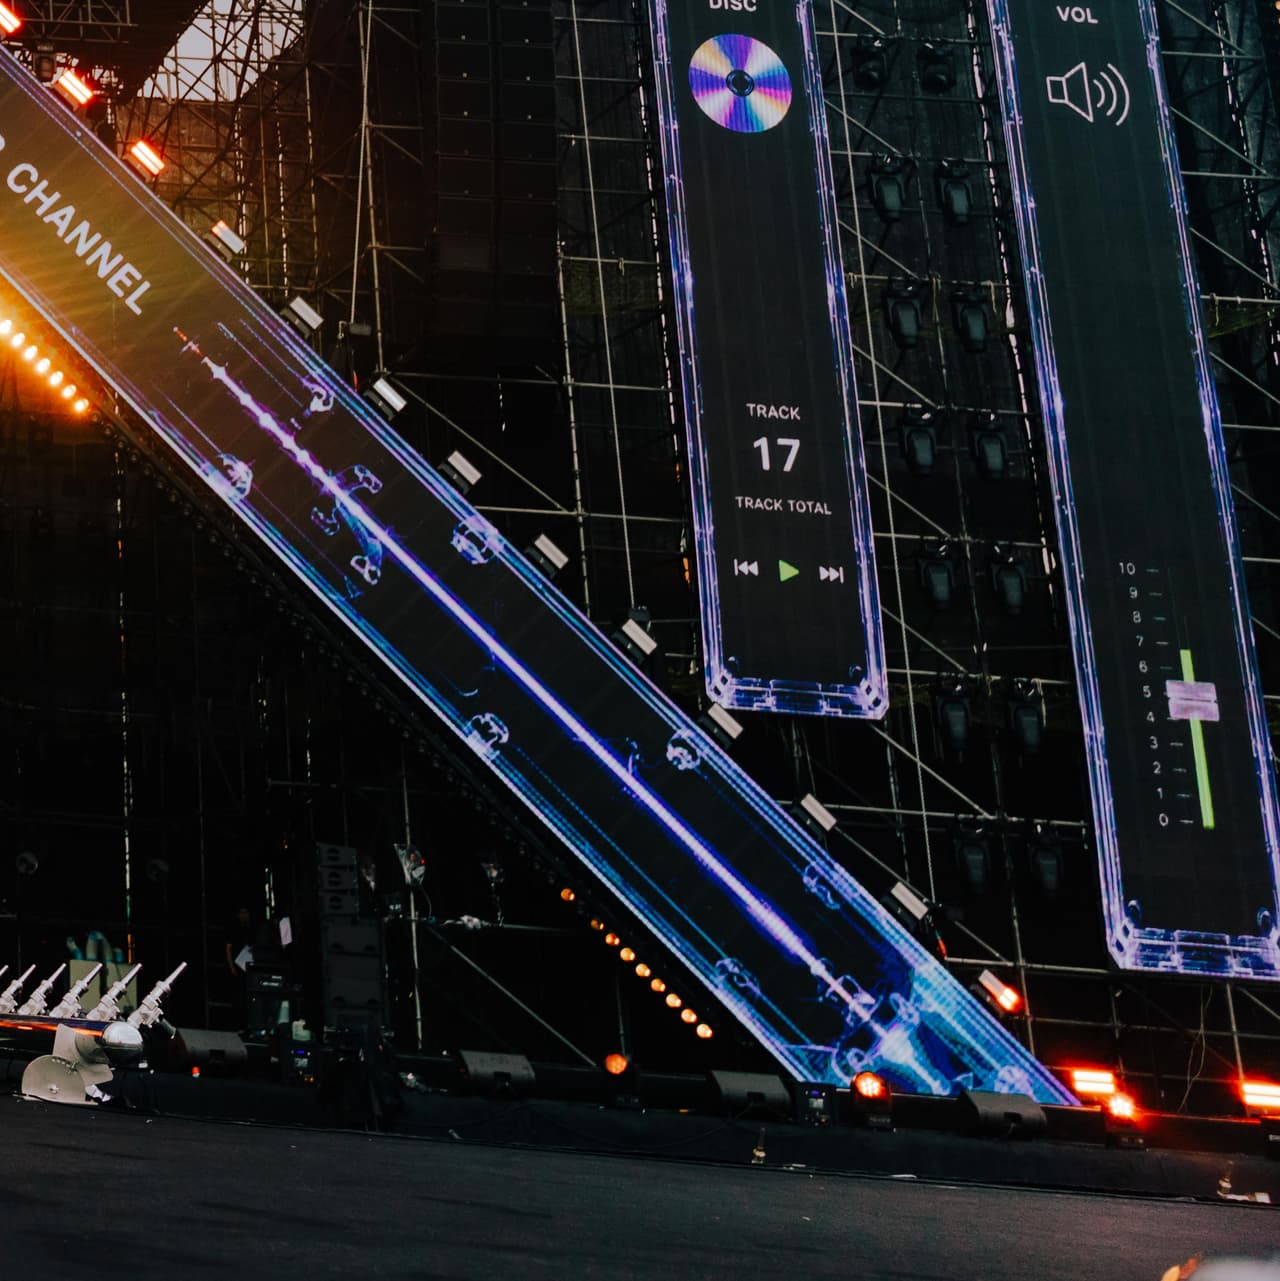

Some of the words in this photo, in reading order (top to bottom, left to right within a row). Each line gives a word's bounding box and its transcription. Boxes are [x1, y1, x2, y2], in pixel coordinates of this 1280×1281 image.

[1055, 5, 1099, 25] VOL
[7, 163, 151, 316] CHANNEL
[745, 402, 801, 421] TRACK
[752, 436, 801, 473] 17
[734, 495, 783, 512] TRACK
[787, 499, 832, 516] TOTAL
[1119, 561, 1136, 576] 10
[1129, 586, 1138, 599] 9
[1132, 610, 1142, 624] 8
[1135, 634, 1144, 647] 7
[1138, 660, 1148, 673] 6
[1142, 685, 1152, 699] 5
[1146, 711, 1155, 723] 4
[1149, 735, 1159, 750] 3
[1152, 760, 1161, 775] 2
[1156, 787, 1163, 800] 1
[1158, 812, 1169, 827] 0
